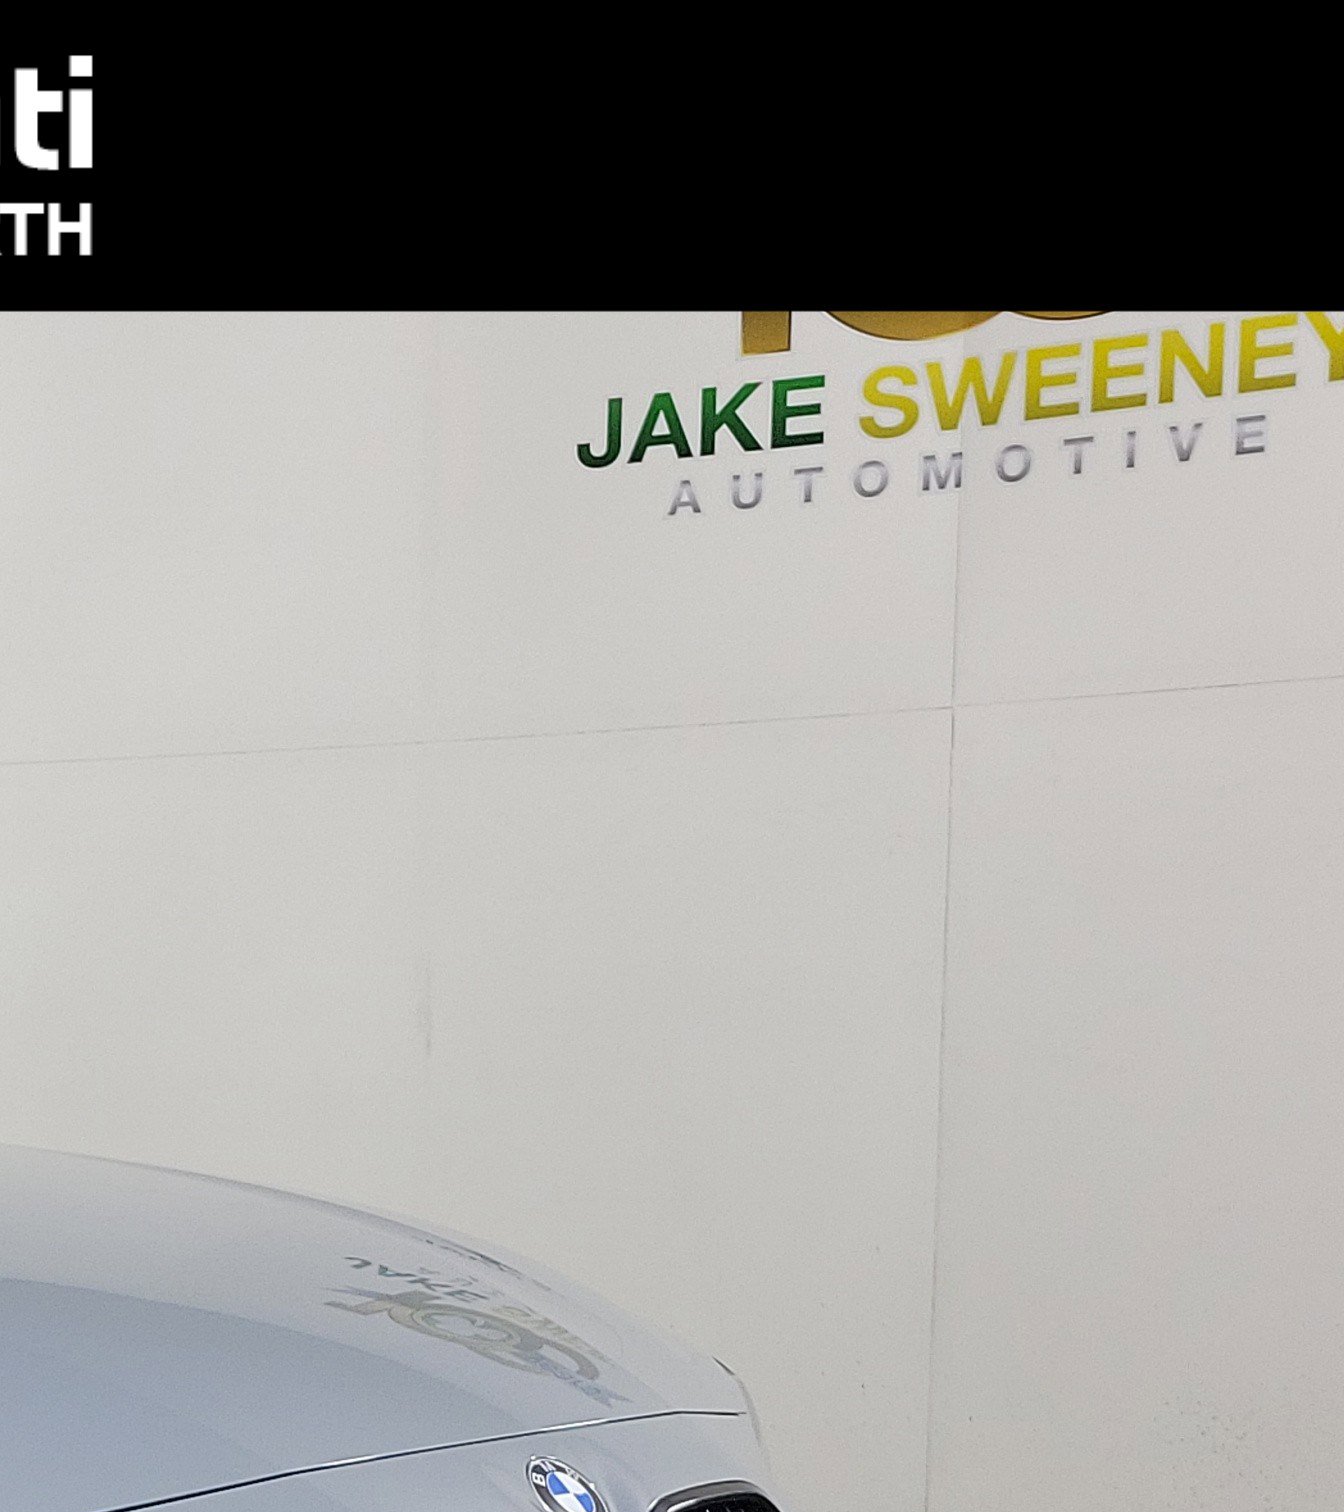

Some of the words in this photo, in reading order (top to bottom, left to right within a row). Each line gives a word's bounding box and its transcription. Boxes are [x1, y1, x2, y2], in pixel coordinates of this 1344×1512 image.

[575, 374, 826, 469] JAKE
[858, 311, 1344, 440] SWEENEY
[667, 414, 1268, 516] AUTOMOTIVE
